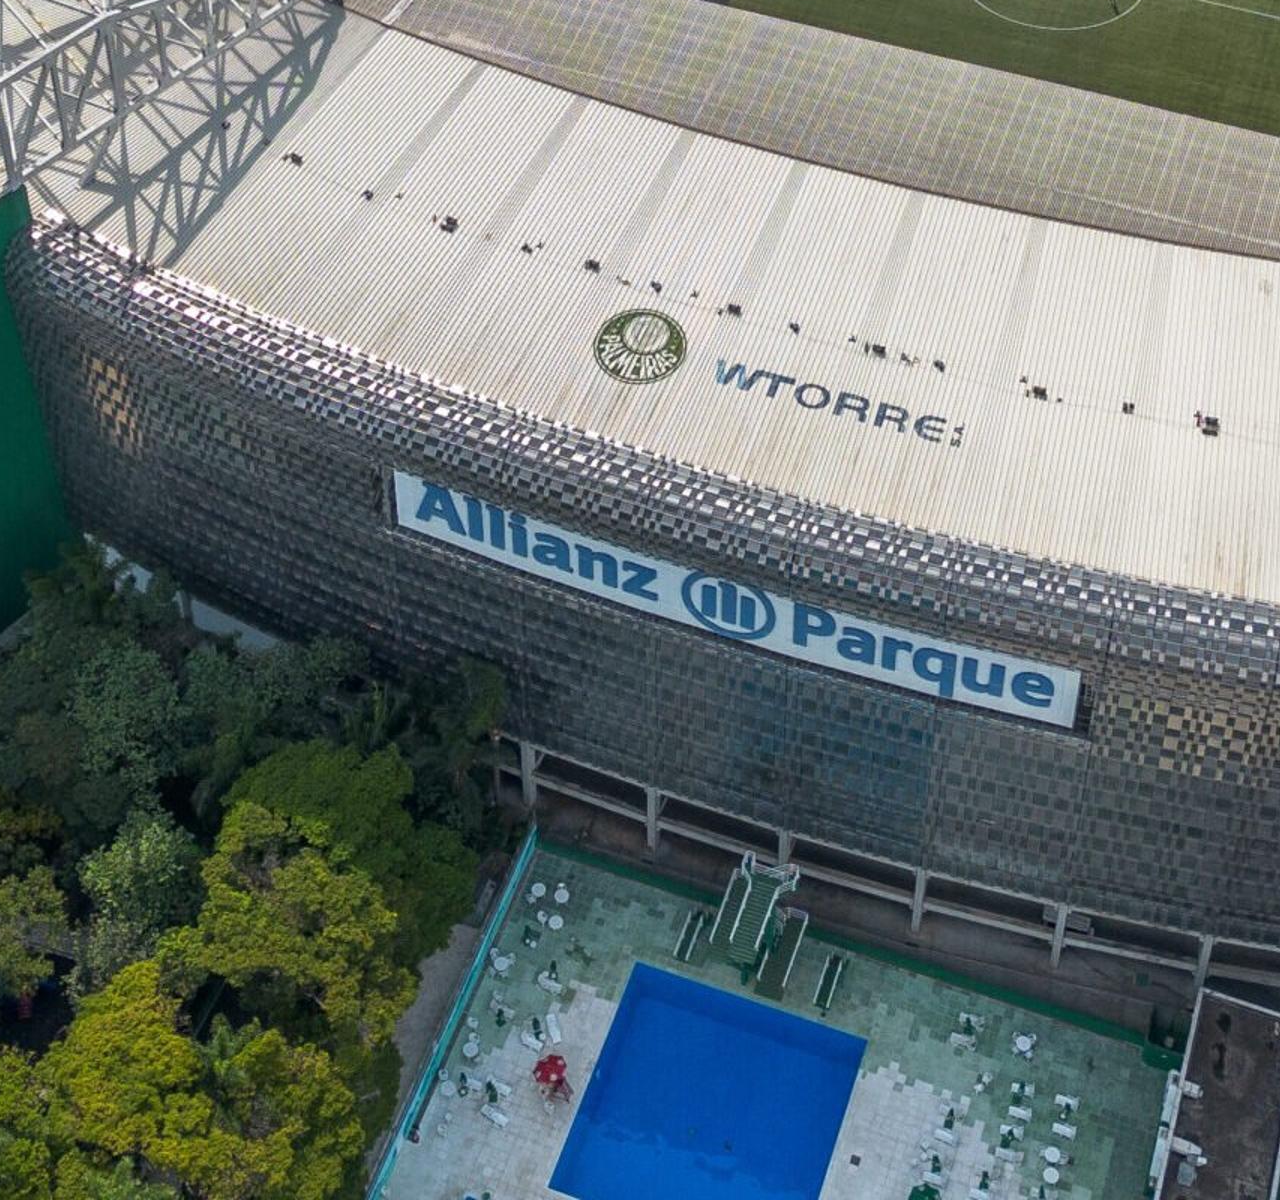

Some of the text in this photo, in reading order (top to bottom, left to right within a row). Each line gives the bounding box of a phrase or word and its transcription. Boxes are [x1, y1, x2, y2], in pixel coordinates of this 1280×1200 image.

[599, 335, 678, 379] PALMEIRAS
[715, 359, 947, 444] WTORRE
[415, 480, 1055, 708] Allianz Parque
